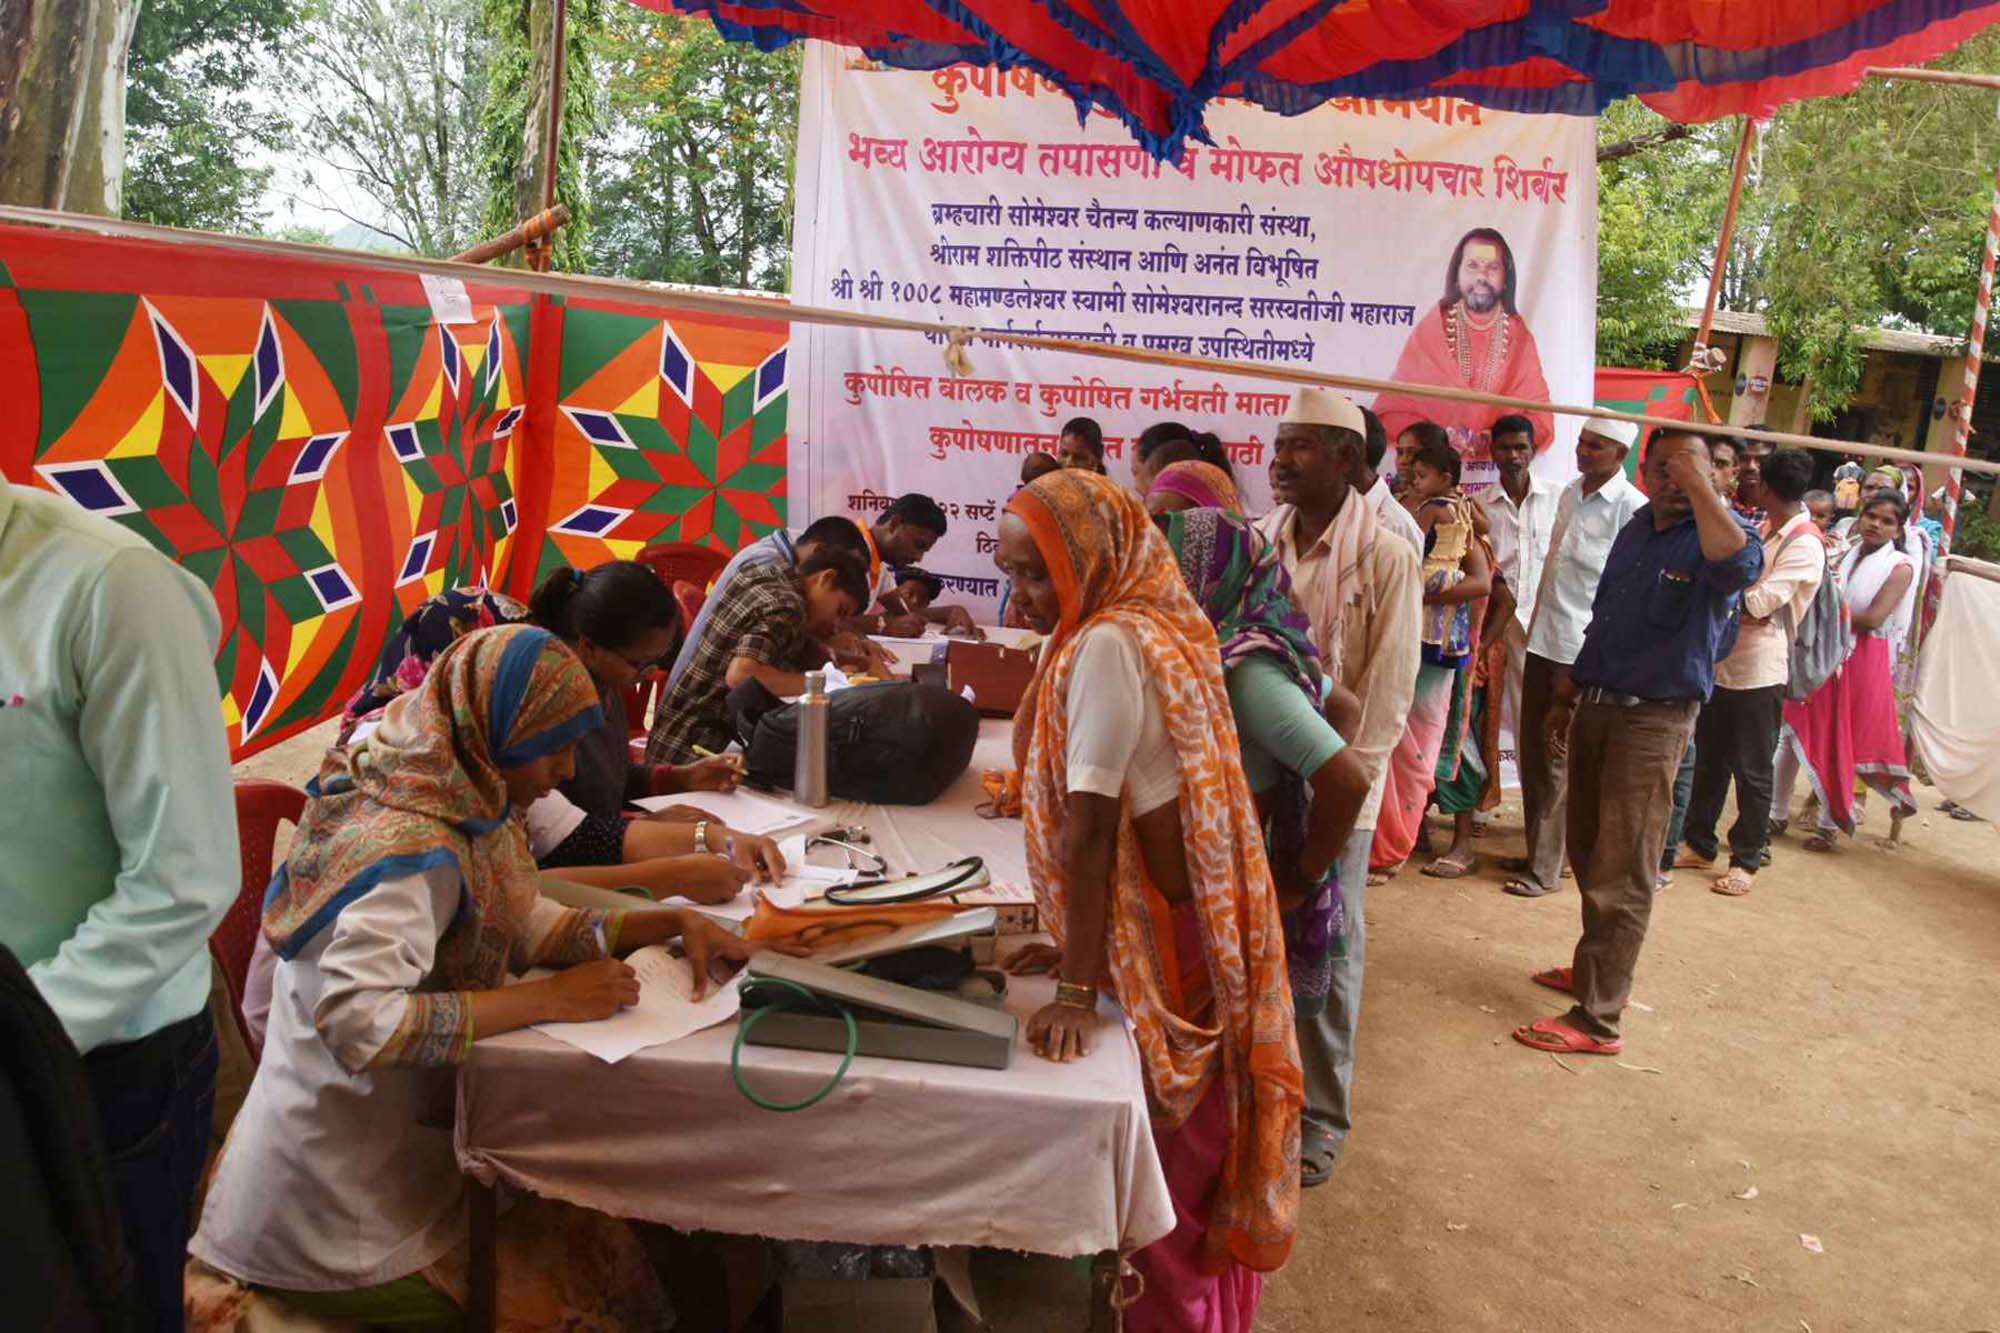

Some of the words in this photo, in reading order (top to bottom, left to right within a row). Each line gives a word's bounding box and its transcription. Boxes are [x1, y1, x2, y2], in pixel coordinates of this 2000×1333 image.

[848, 130, 908, 171] भव्य
[919, 126, 1026, 175] आरोग्य
[1209, 135, 1304, 186] मोफत
[1314, 143, 1485, 198] औषधोपचार
[1008, 196, 1080, 228] सोमेश्वर
[1086, 198, 1138, 230] चैतन्य
[1144, 203, 1254, 235] कल्याणकारी
[1260, 206, 1317, 242] संस्था,
[930, 235, 980, 267] श्रीराम
[986, 237, 1062, 269] शक्तिपीठ
[1069, 239, 1131, 271] संस्थान
[1138, 243, 1187, 274] आणि
[1194, 246, 1240, 276] अनंत
[1246, 247, 1319, 288] विभूषित
[831, 268, 853, 300] श्री
[859, 270, 882, 301] श्री
[890, 281, 941, 304] १००८
[949, 279, 1067, 310] महामण्डलेश्वर
[1073, 281, 1126, 313] स्वामी
[1132, 285, 1243, 319] सोमेश्वरानन्द
[1250, 288, 1344, 323] सरस्वतीजी
[1350, 302, 1416, 327] महाराज
[1198, 328, 1315, 362] उपस्थितीमध्ये
[843, 365, 932, 405] कुपोषित
[938, 377, 1009, 403] बालक
[1015, 383, 1032, 405] व
[1039, 376, 1133, 418] कुपोषित
[1139, 379, 1229, 415] गर्भवती
[1235, 391, 1291, 418] माता
